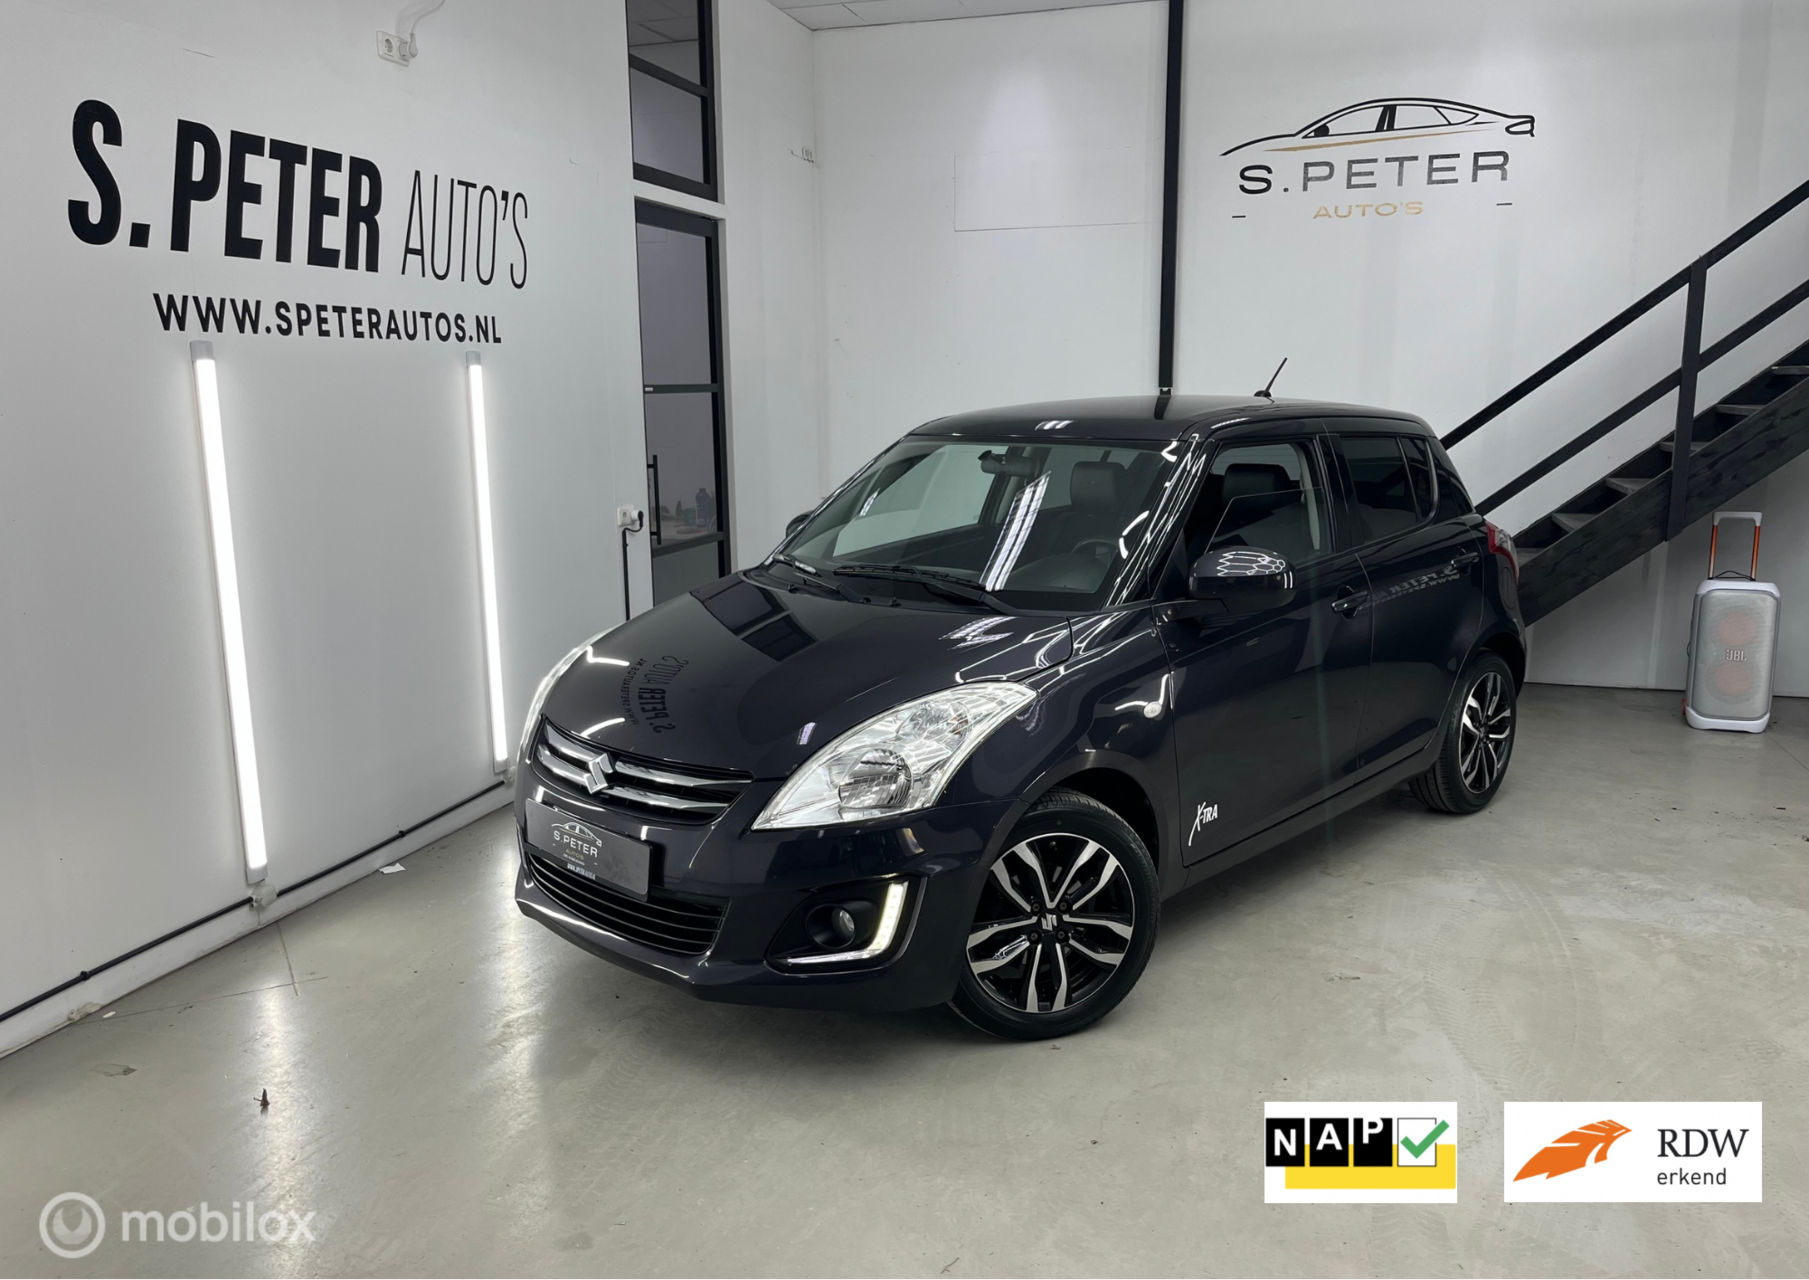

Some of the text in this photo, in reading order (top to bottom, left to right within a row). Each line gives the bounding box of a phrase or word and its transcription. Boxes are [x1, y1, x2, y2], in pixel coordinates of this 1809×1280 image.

[170, 118, 383, 273] PETER
[401, 170, 528, 290] AUTO'S
[1312, 201, 1424, 220] AUTO'S
[152, 292, 502, 344] WWW.SPETERAUTOS.NL
[1725, 648, 1747, 662] JBL
[1188, 801, 1218, 847] X-TRA
